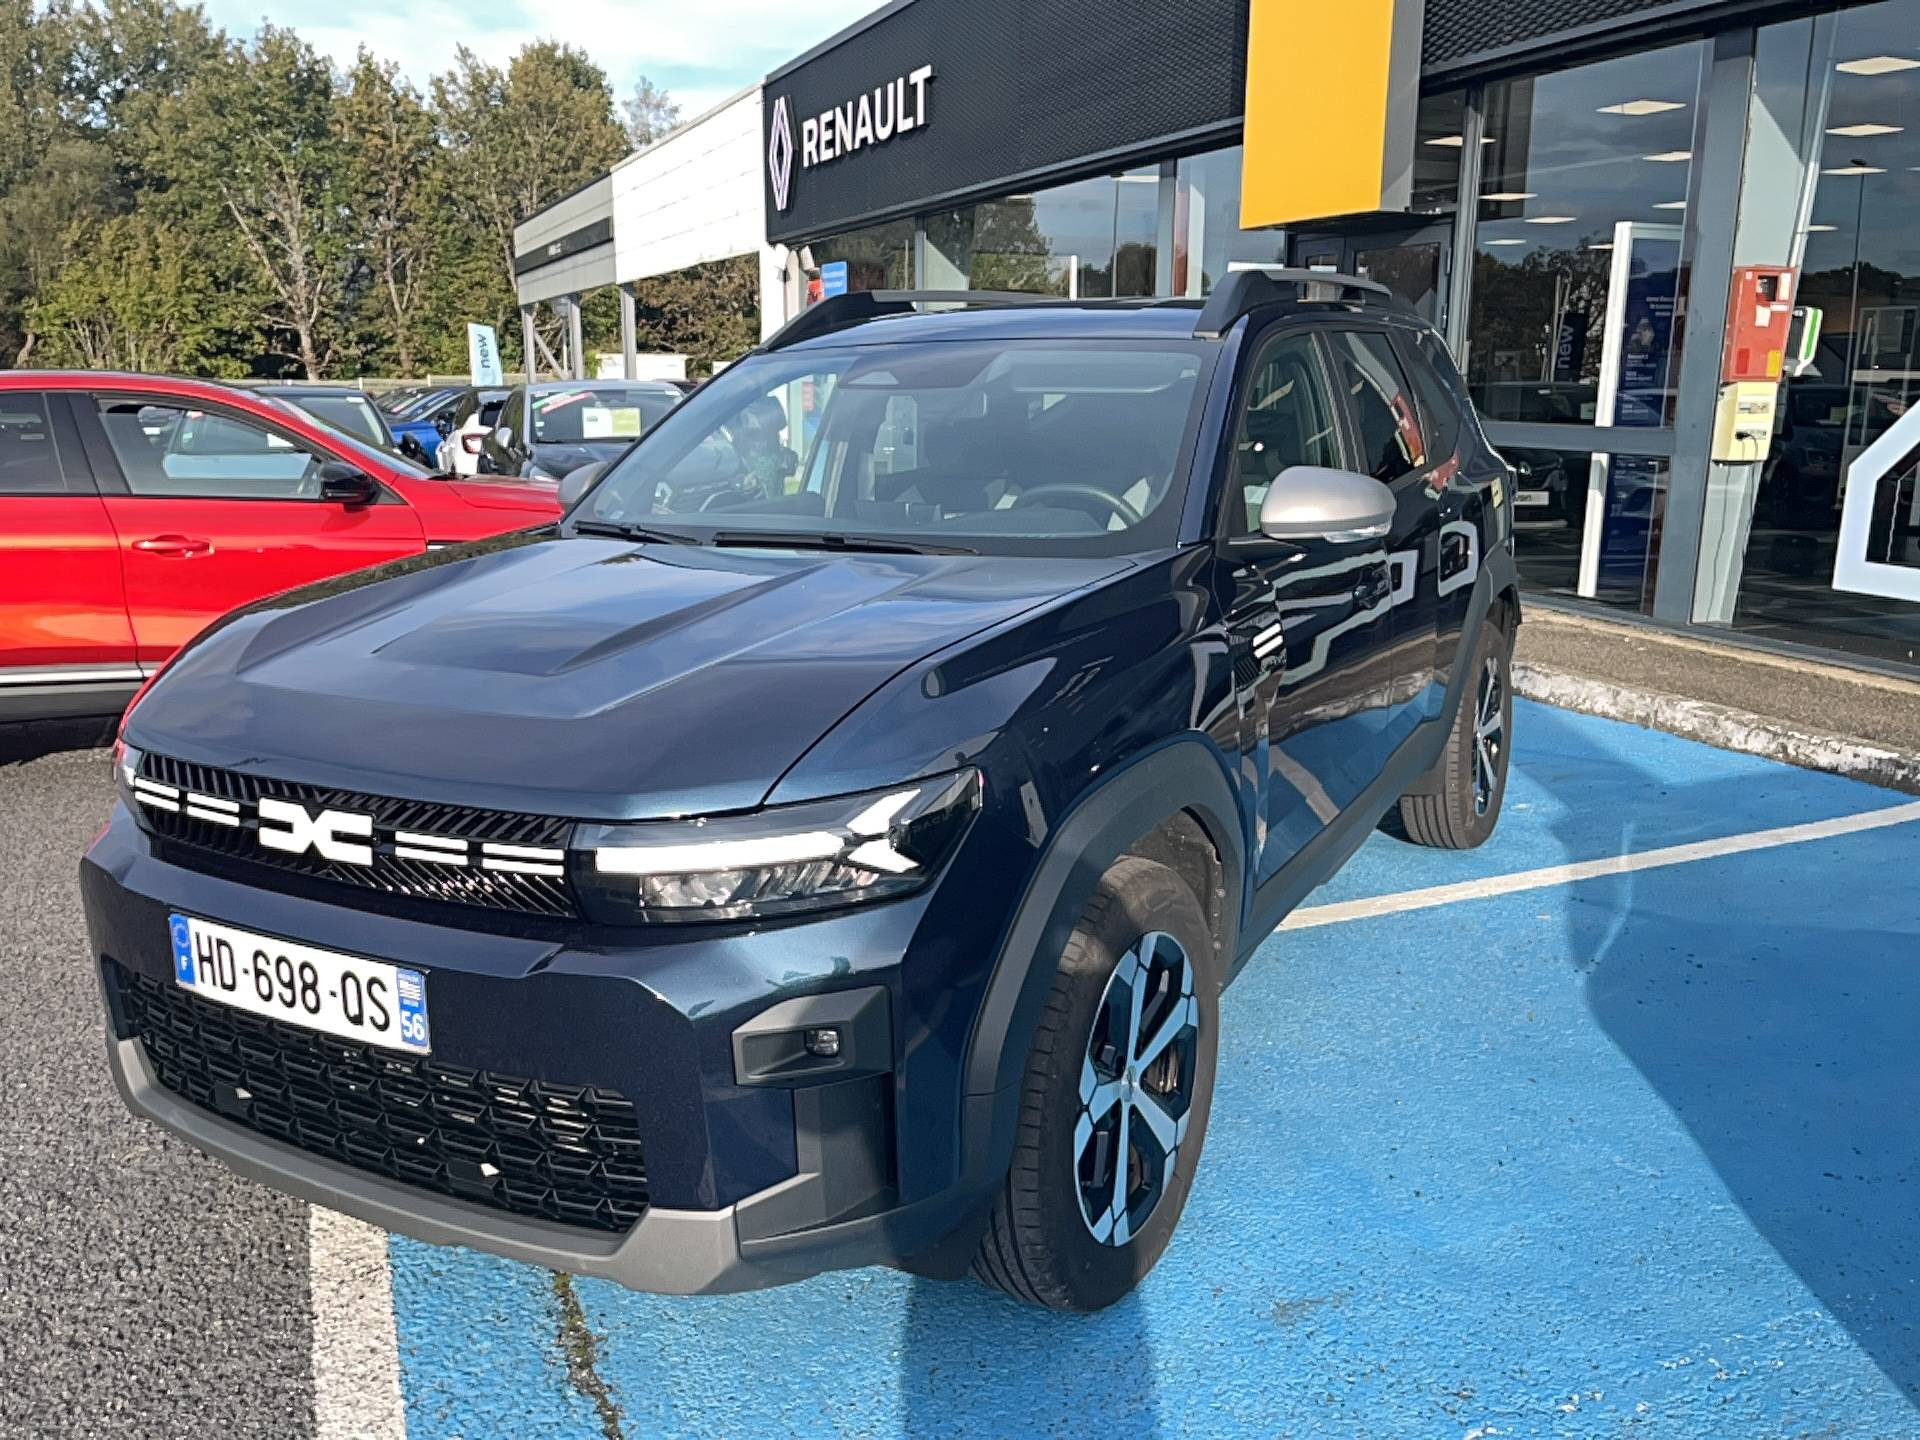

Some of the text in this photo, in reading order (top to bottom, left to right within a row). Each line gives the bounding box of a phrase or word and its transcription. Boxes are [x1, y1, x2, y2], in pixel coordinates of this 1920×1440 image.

[803, 65, 931, 168] RENAULT
[477, 334, 490, 368] new
[1557, 325, 1574, 369] new
[194, 931, 390, 1032] HD-698-QS
[401, 1011, 425, 1041] 56
